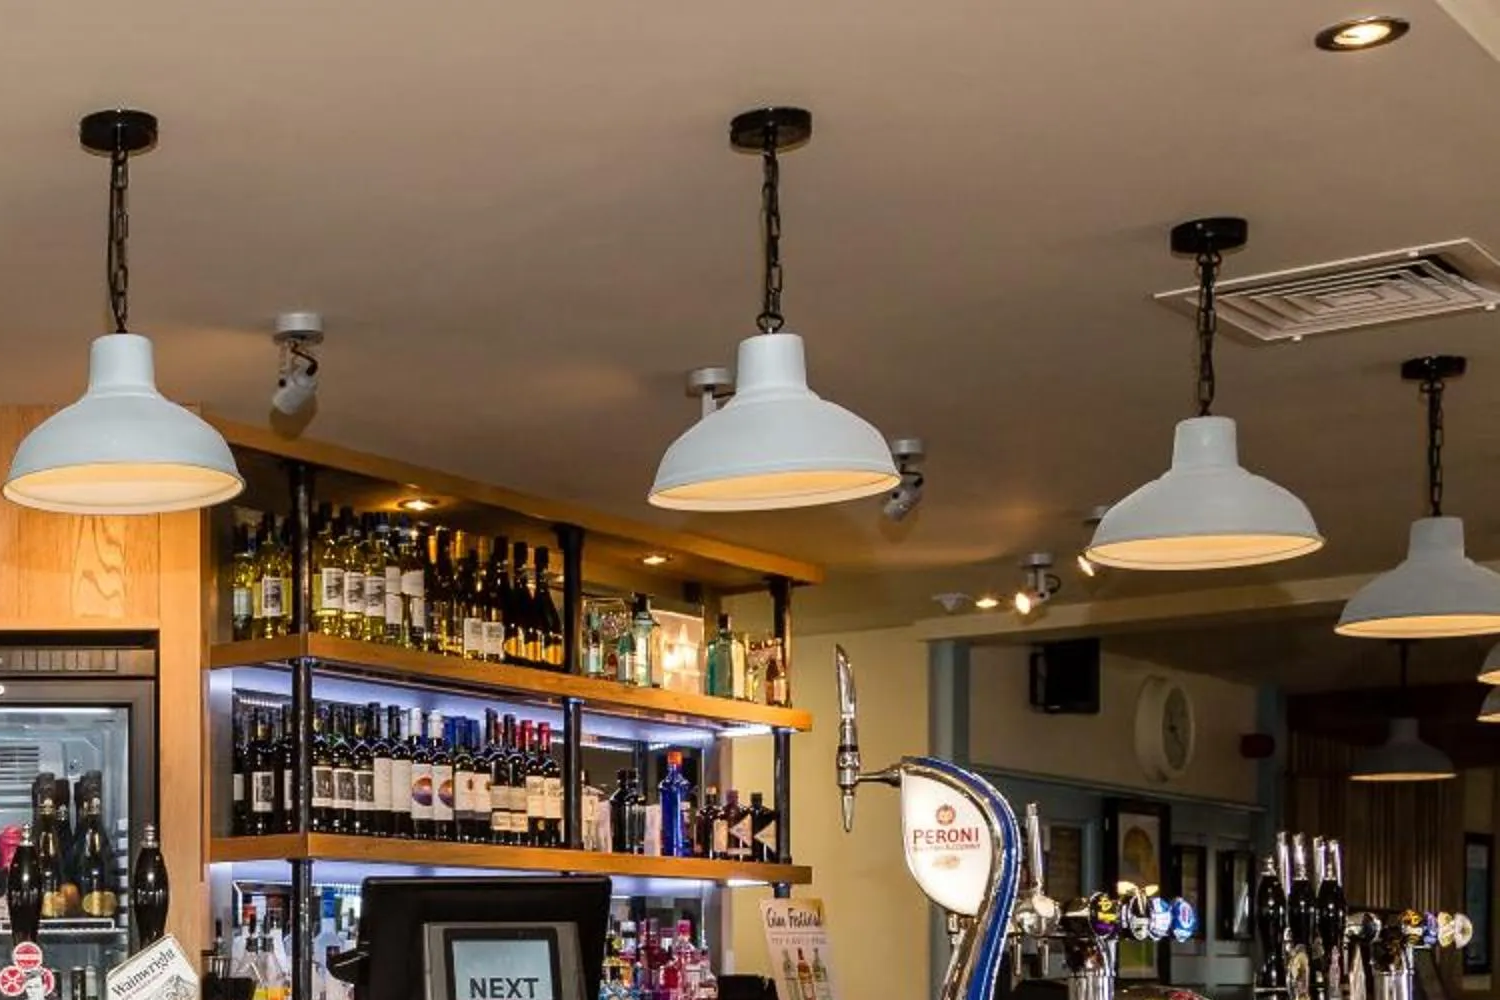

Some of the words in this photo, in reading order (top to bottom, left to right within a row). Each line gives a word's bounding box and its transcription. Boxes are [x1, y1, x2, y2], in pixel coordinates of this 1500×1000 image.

[912, 827, 980, 845] PERONI
[111, 947, 176, 997] Wainwright
[469, 977, 540, 999] NEXT
